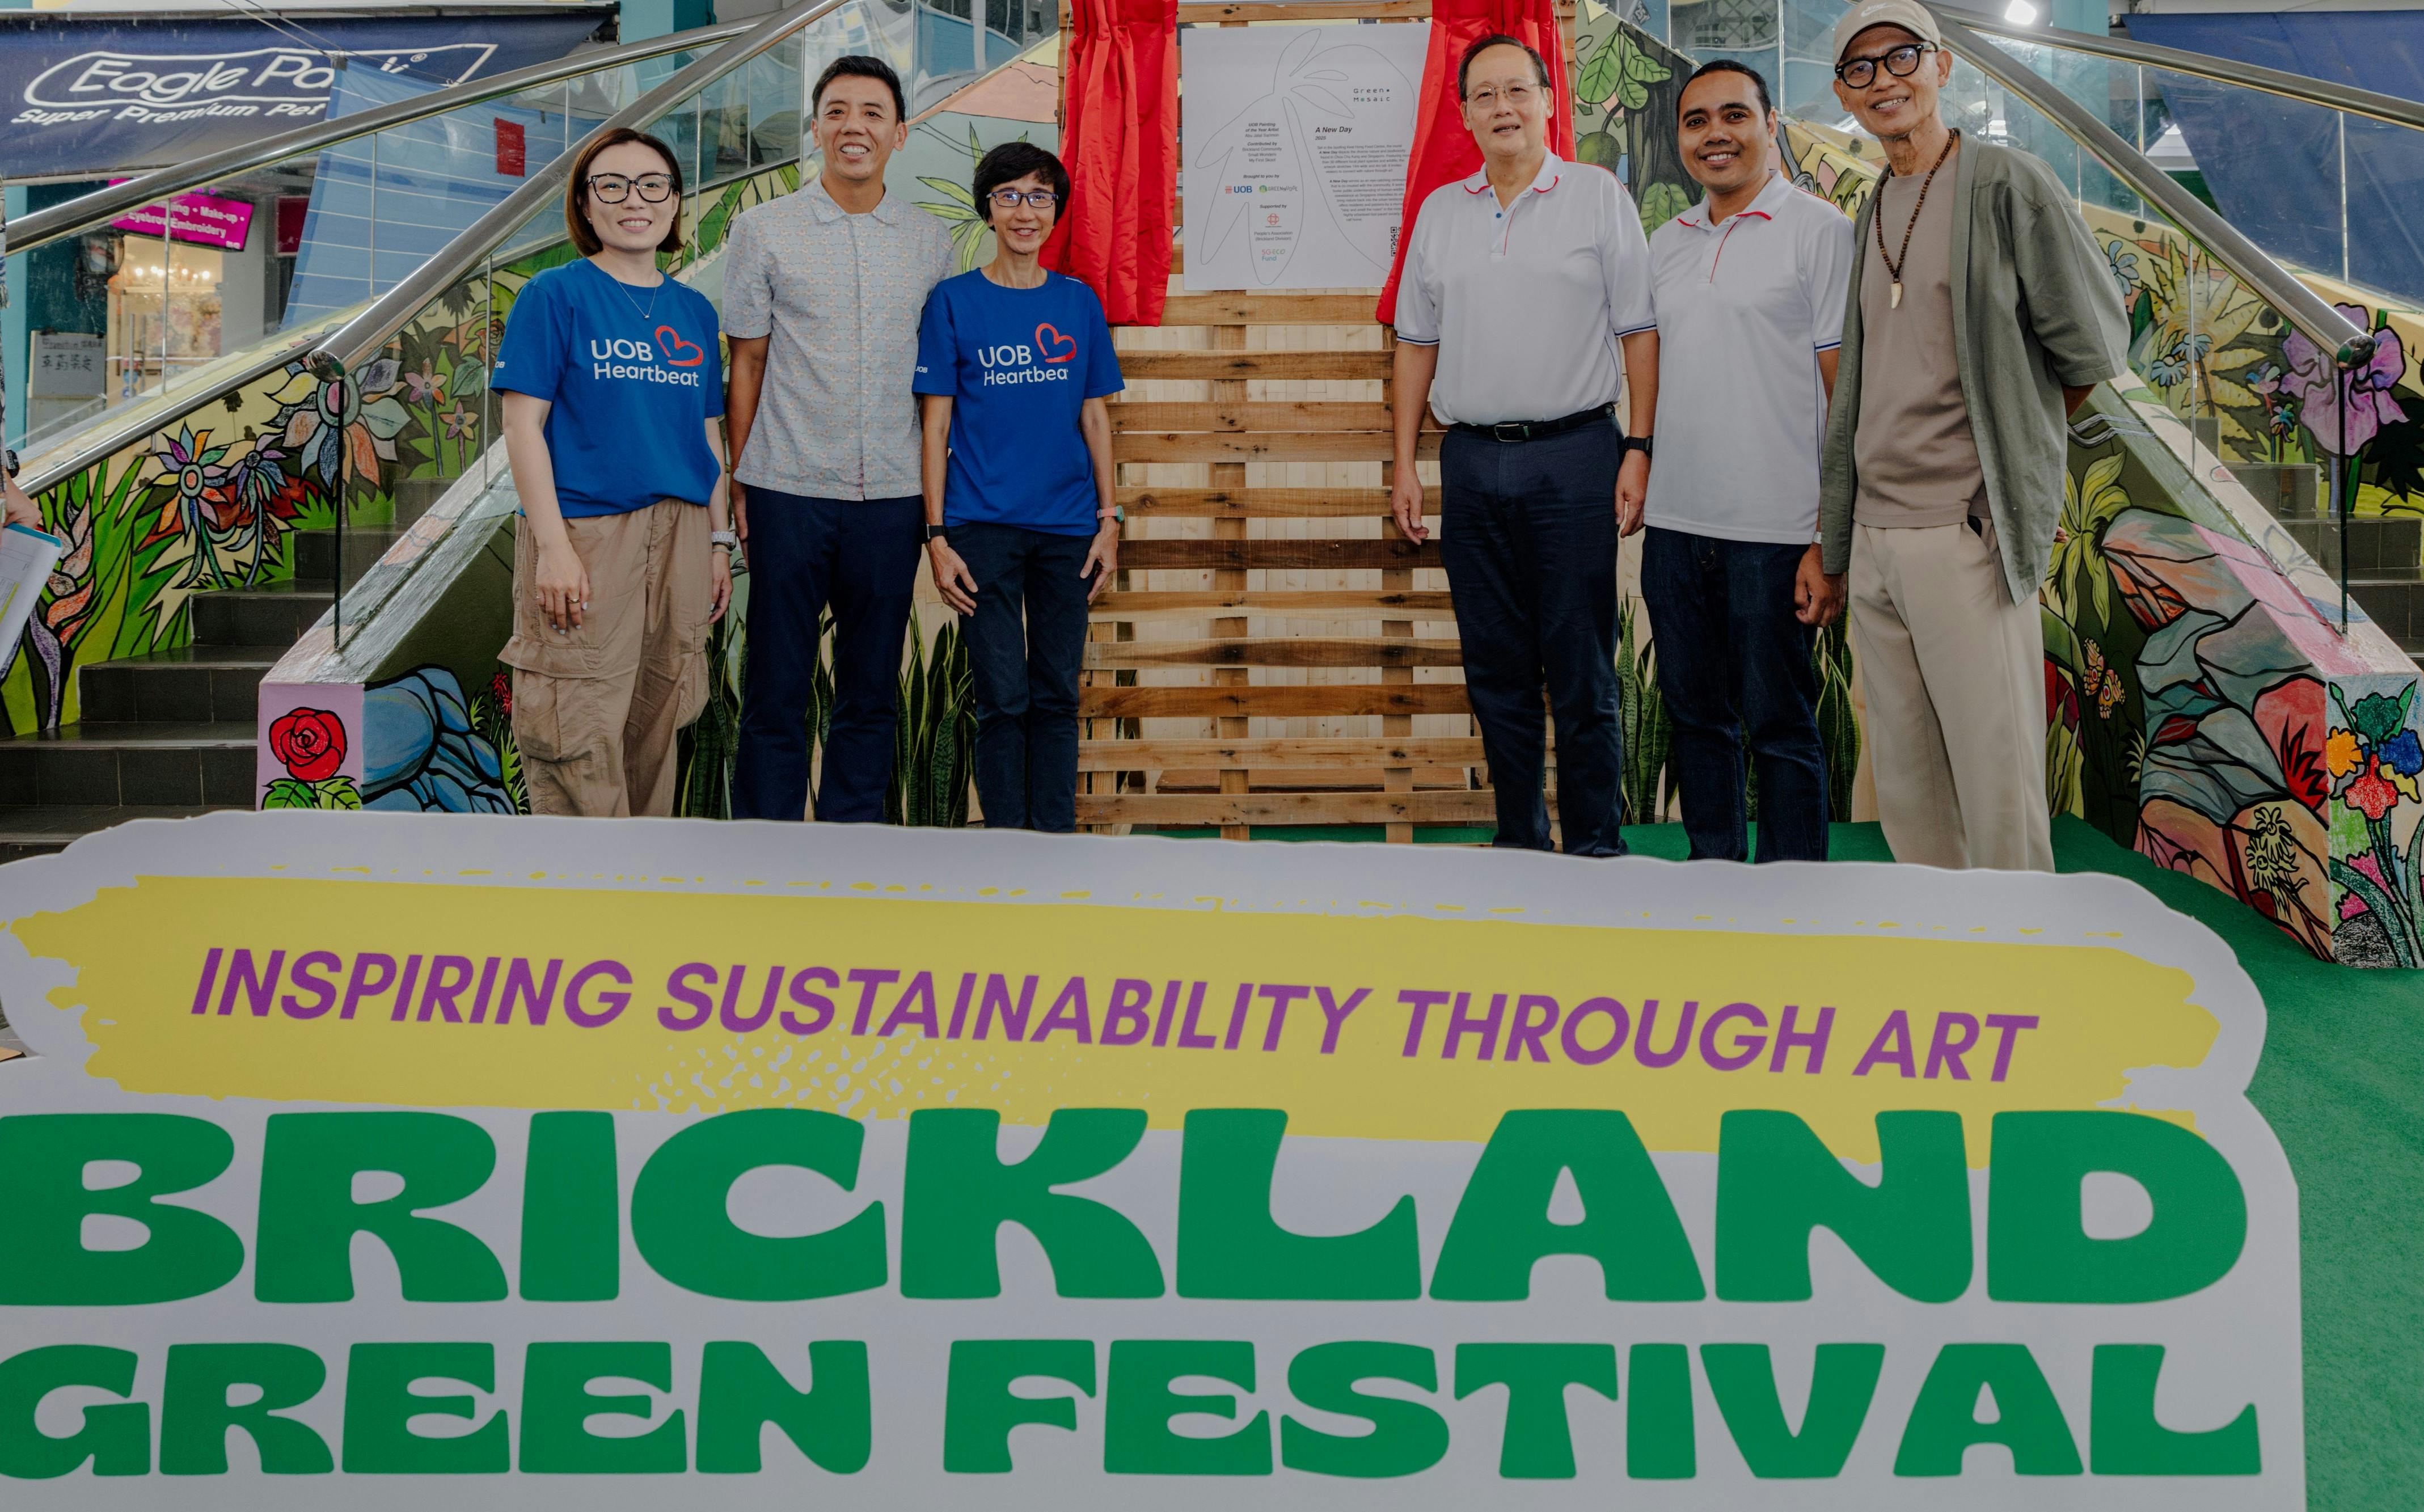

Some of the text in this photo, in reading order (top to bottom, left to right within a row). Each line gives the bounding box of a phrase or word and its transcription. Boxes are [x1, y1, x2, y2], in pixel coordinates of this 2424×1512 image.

[69, 60, 249, 103] Eagle
[11, 102, 327, 126] Super Premium Pet
[128, 212, 226, 239] Eyebro Embroidery
[200, 206, 238, 224] Make-up
[591, 339, 653, 361] UOB
[978, 345, 1032, 368] UOB
[594, 362, 699, 387] Heartbeat
[984, 366, 1069, 386] Heartbea
[191, 948, 2039, 1082] INSPIRING SUSTAINABILITY THROUGH ART
[0, 1109, 2246, 1306] BRICKLAND
[0, 1340, 2261, 1480] GREEN FESTIVAL
